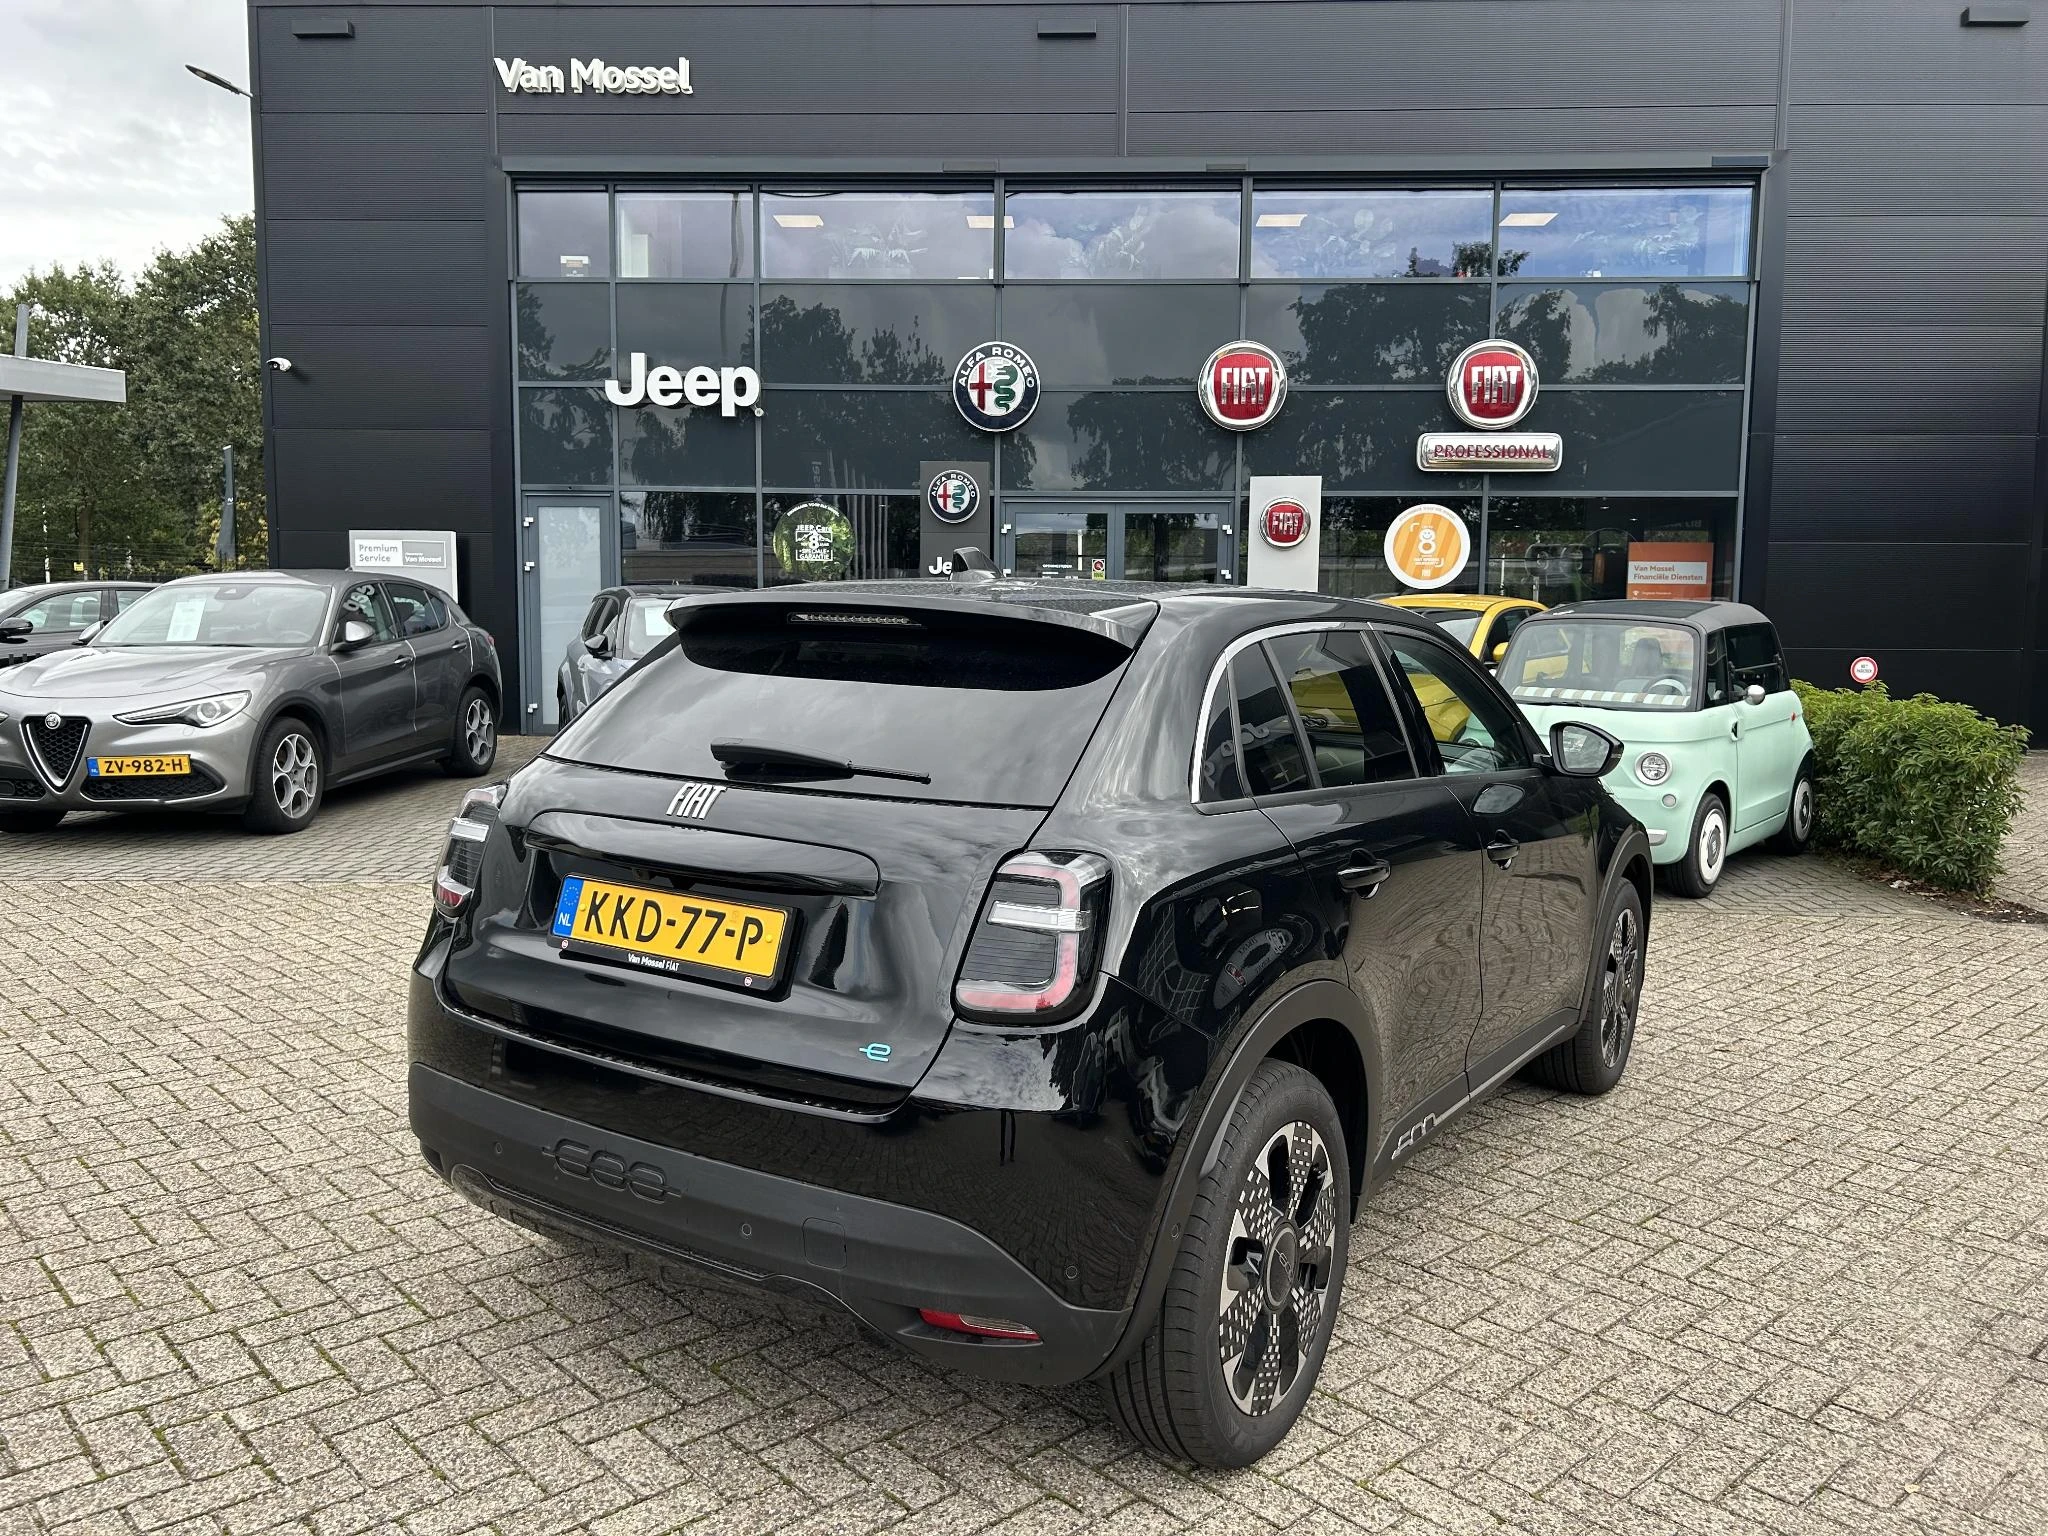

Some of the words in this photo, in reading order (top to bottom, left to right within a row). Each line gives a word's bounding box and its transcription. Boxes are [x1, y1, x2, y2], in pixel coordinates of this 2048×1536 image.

[494, 57, 564, 93] Van
[570, 56, 693, 94] Mossel
[959, 351, 986, 387] ALFA
[991, 346, 1035, 388] ROMEO
[604, 352, 760, 417] Jeep
[1220, 367, 1270, 405] FIAT
[1470, 365, 1522, 404] FIAT
[1433, 444, 1551, 459] PROFESSIONAL
[931, 476, 948, 497] ALFA
[950, 473, 976, 498] ROMEO
[1271, 511, 1302, 536] FIAT
[359, 543, 398, 553] Premium
[1418, 528, 1437, 555] 8
[359, 553, 392, 562] Service
[1633, 564, 1648, 572] Van
[1649, 564, 1675, 572] Mossel
[1670, 573, 1703, 581] Diensten
[104, 758, 182, 774] ZV-982-H
[665, 782, 727, 820] FIAT
[557, 912, 572, 927] NL
[584, 890, 764, 961] KKD-77-P
[627, 952, 641, 964] Van
[641, 955, 666, 969] Mossel
[665, 960, 680, 972] FIAT
[545, 1138, 679, 1204] 600
